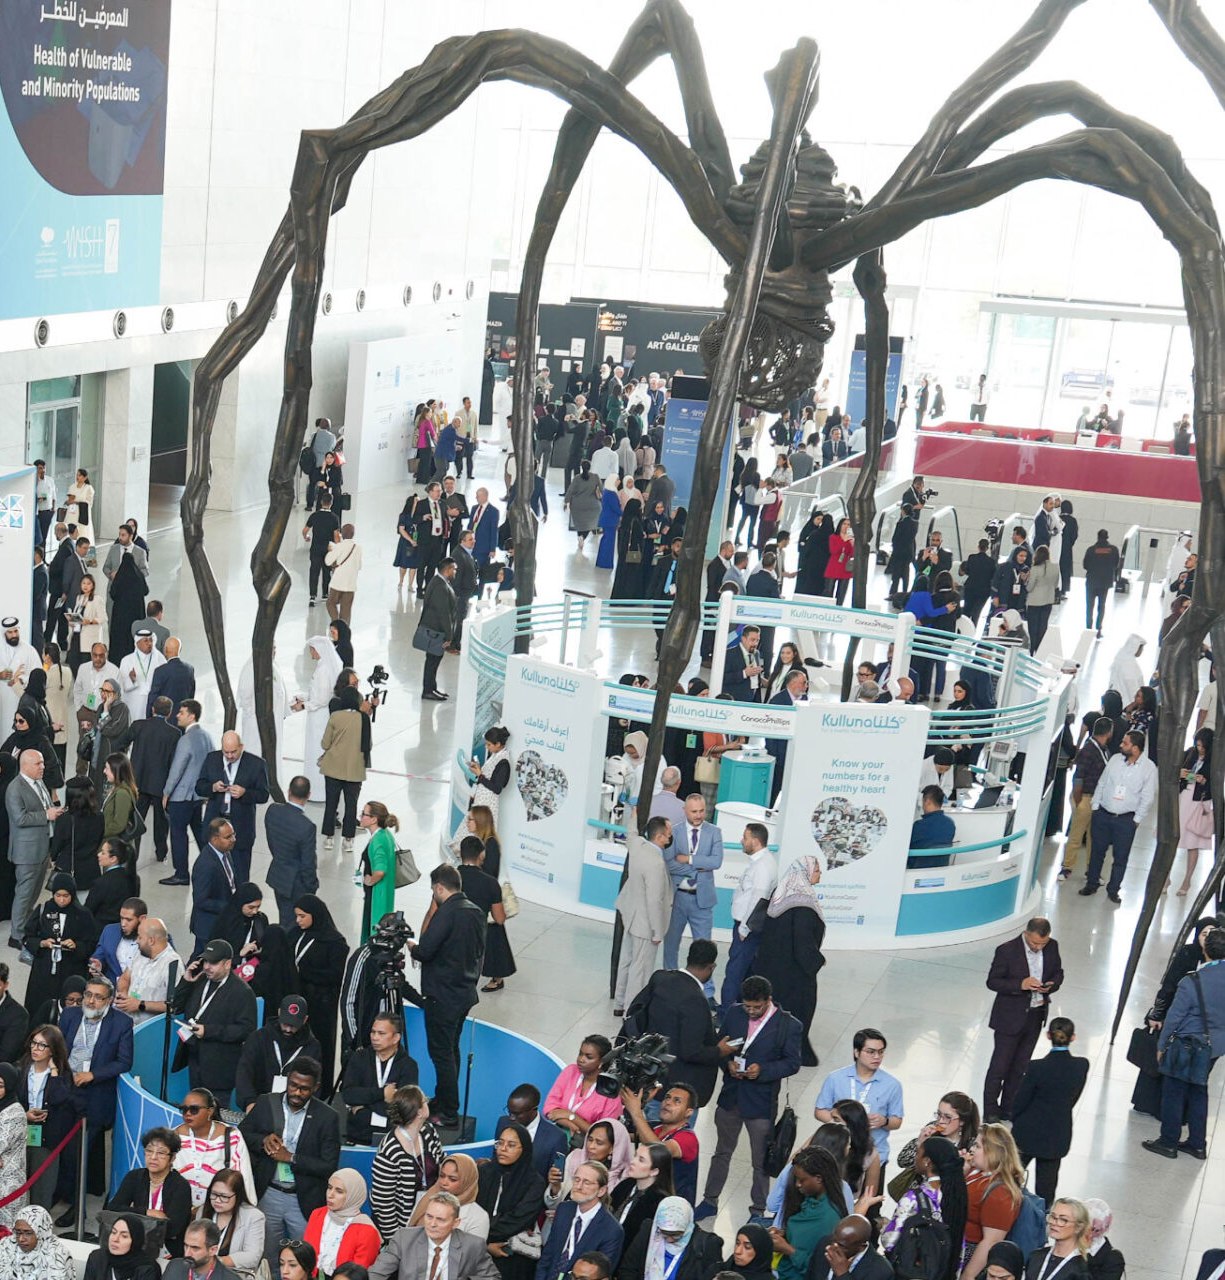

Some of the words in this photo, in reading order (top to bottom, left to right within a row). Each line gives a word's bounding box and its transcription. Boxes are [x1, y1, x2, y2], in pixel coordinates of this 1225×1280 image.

[34, 44, 67, 67] Health
[69, 48, 80, 68] of
[81, 48, 132, 72] Vulnerable
[22, 76, 41, 96] and
[43, 76, 84, 103] Minority
[86, 79, 140, 104] Populations
[646, 340, 664, 350] ART
[665, 342, 700, 352] GALLER
[522, 666, 557, 688] Kulluna
[740, 714, 790, 726] ConocoPhillips
[822, 714, 873, 728] Kulluna
[832, 759, 860, 768] Know
[861, 761, 885, 770] your
[822, 772, 865, 780] numbers
[868, 772, 882, 782] for
[883, 774, 890, 782] a
[822, 784, 859, 795] healthy
[860, 785, 886, 794] heart
